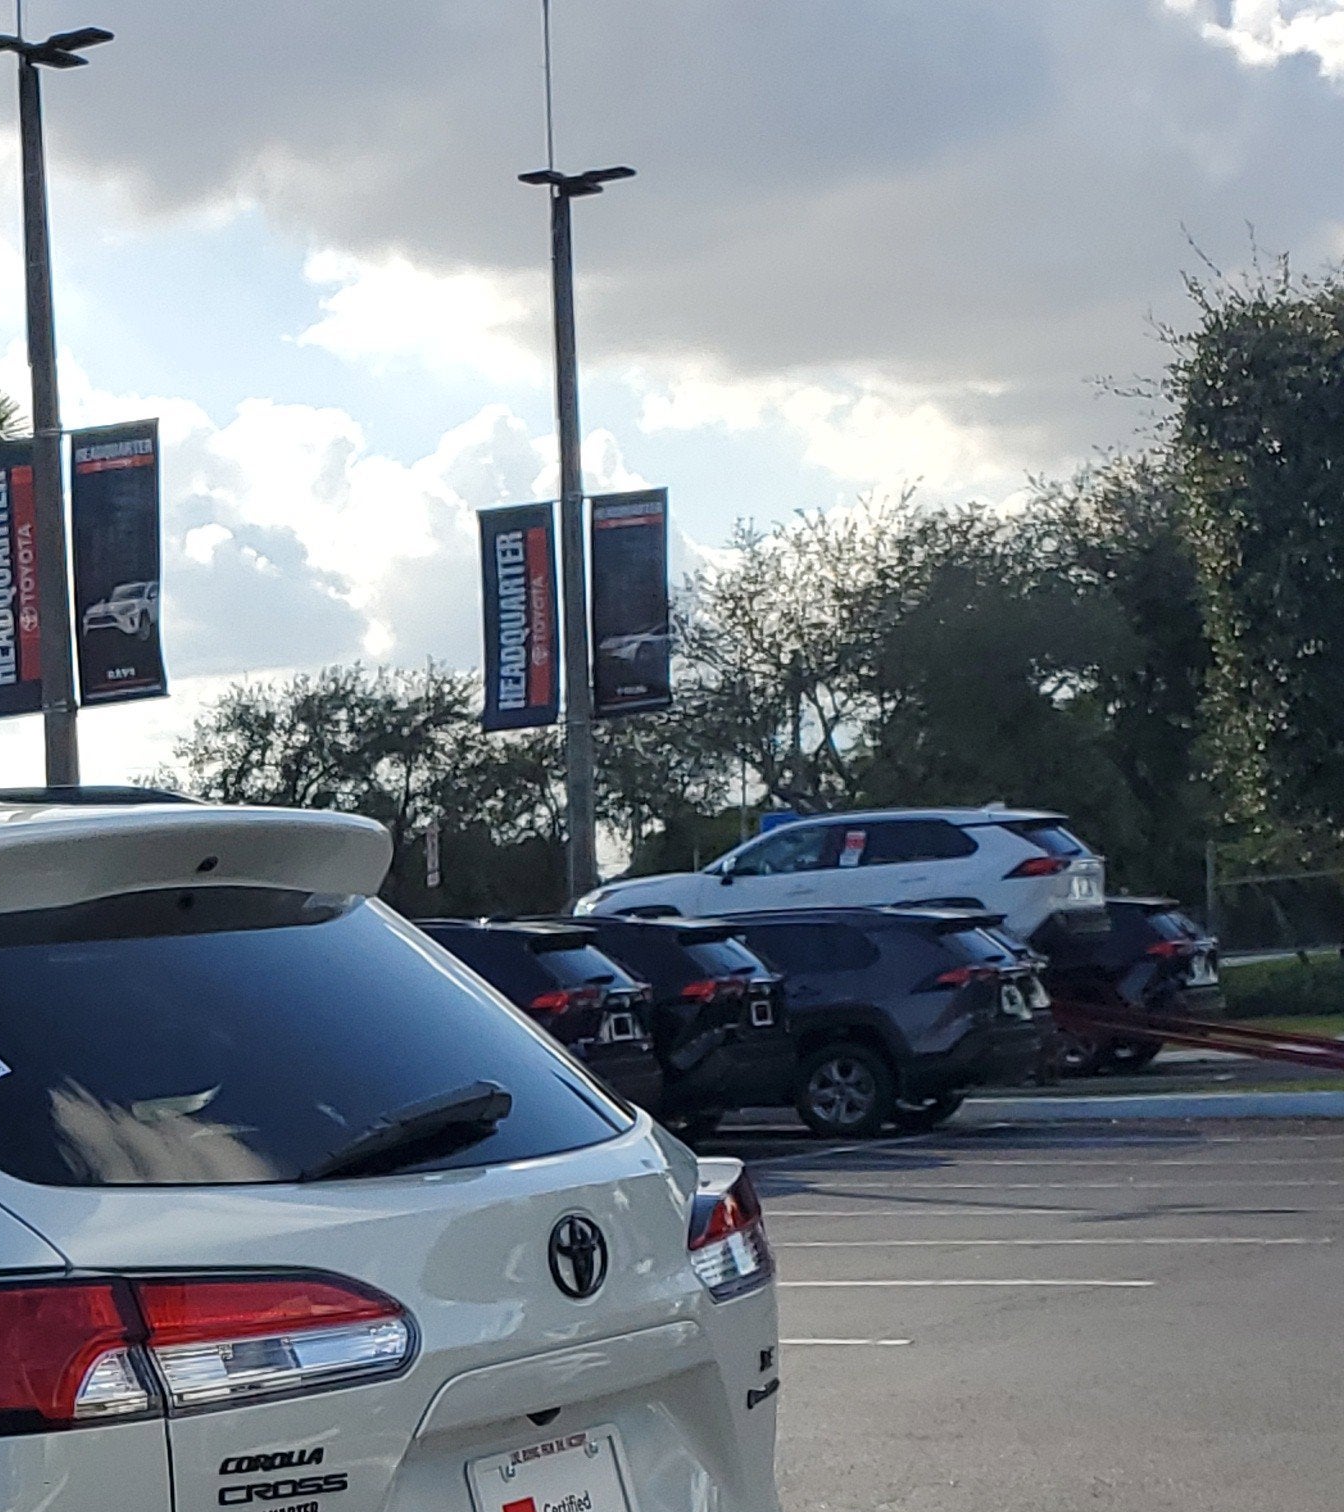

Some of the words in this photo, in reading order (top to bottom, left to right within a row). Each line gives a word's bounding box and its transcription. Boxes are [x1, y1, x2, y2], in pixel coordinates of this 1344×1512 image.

[17, 523, 36, 603] TOYOTA
[495, 530, 528, 711] HEADQUARTER
[218, 1447, 325, 1476] COROLLA
[218, 1472, 348, 1506] CROSS
